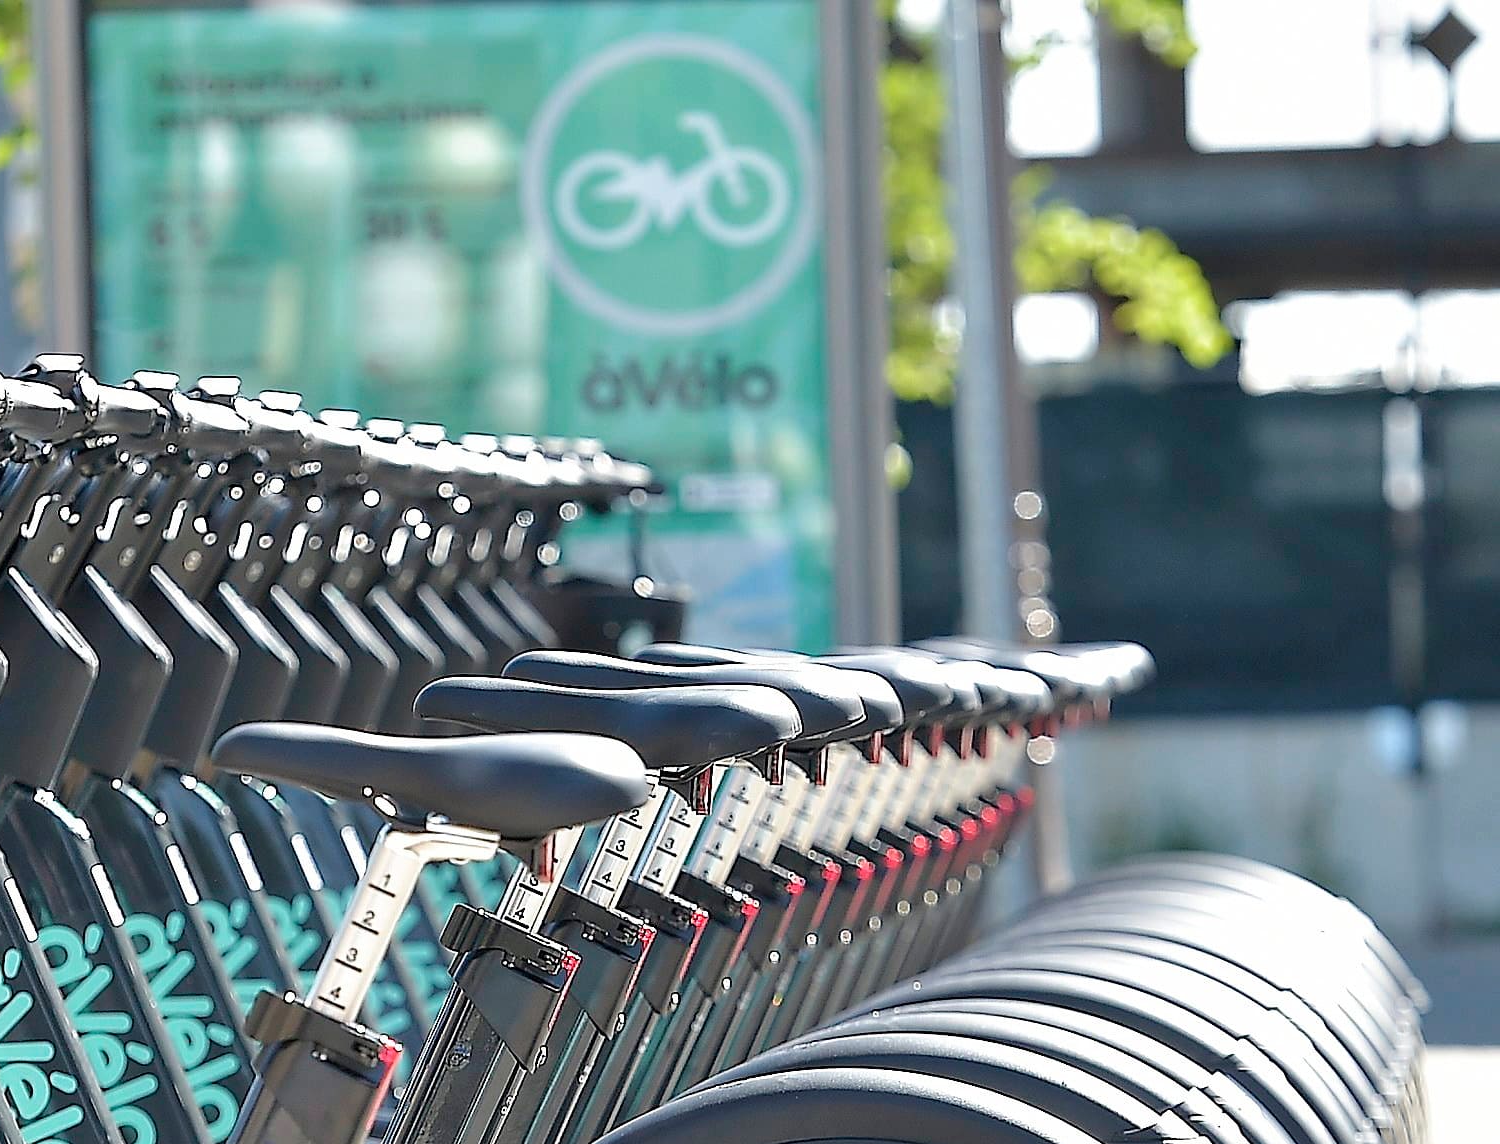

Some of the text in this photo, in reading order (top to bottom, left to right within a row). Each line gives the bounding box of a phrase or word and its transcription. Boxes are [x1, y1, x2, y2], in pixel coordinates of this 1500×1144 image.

[615, 840, 626, 852] 3
[382, 873, 392, 887] 1
[602, 872, 612, 883] 4
[362, 910, 375, 926] 2
[346, 947, 358, 962] 3
[330, 986, 342, 1000] 4
